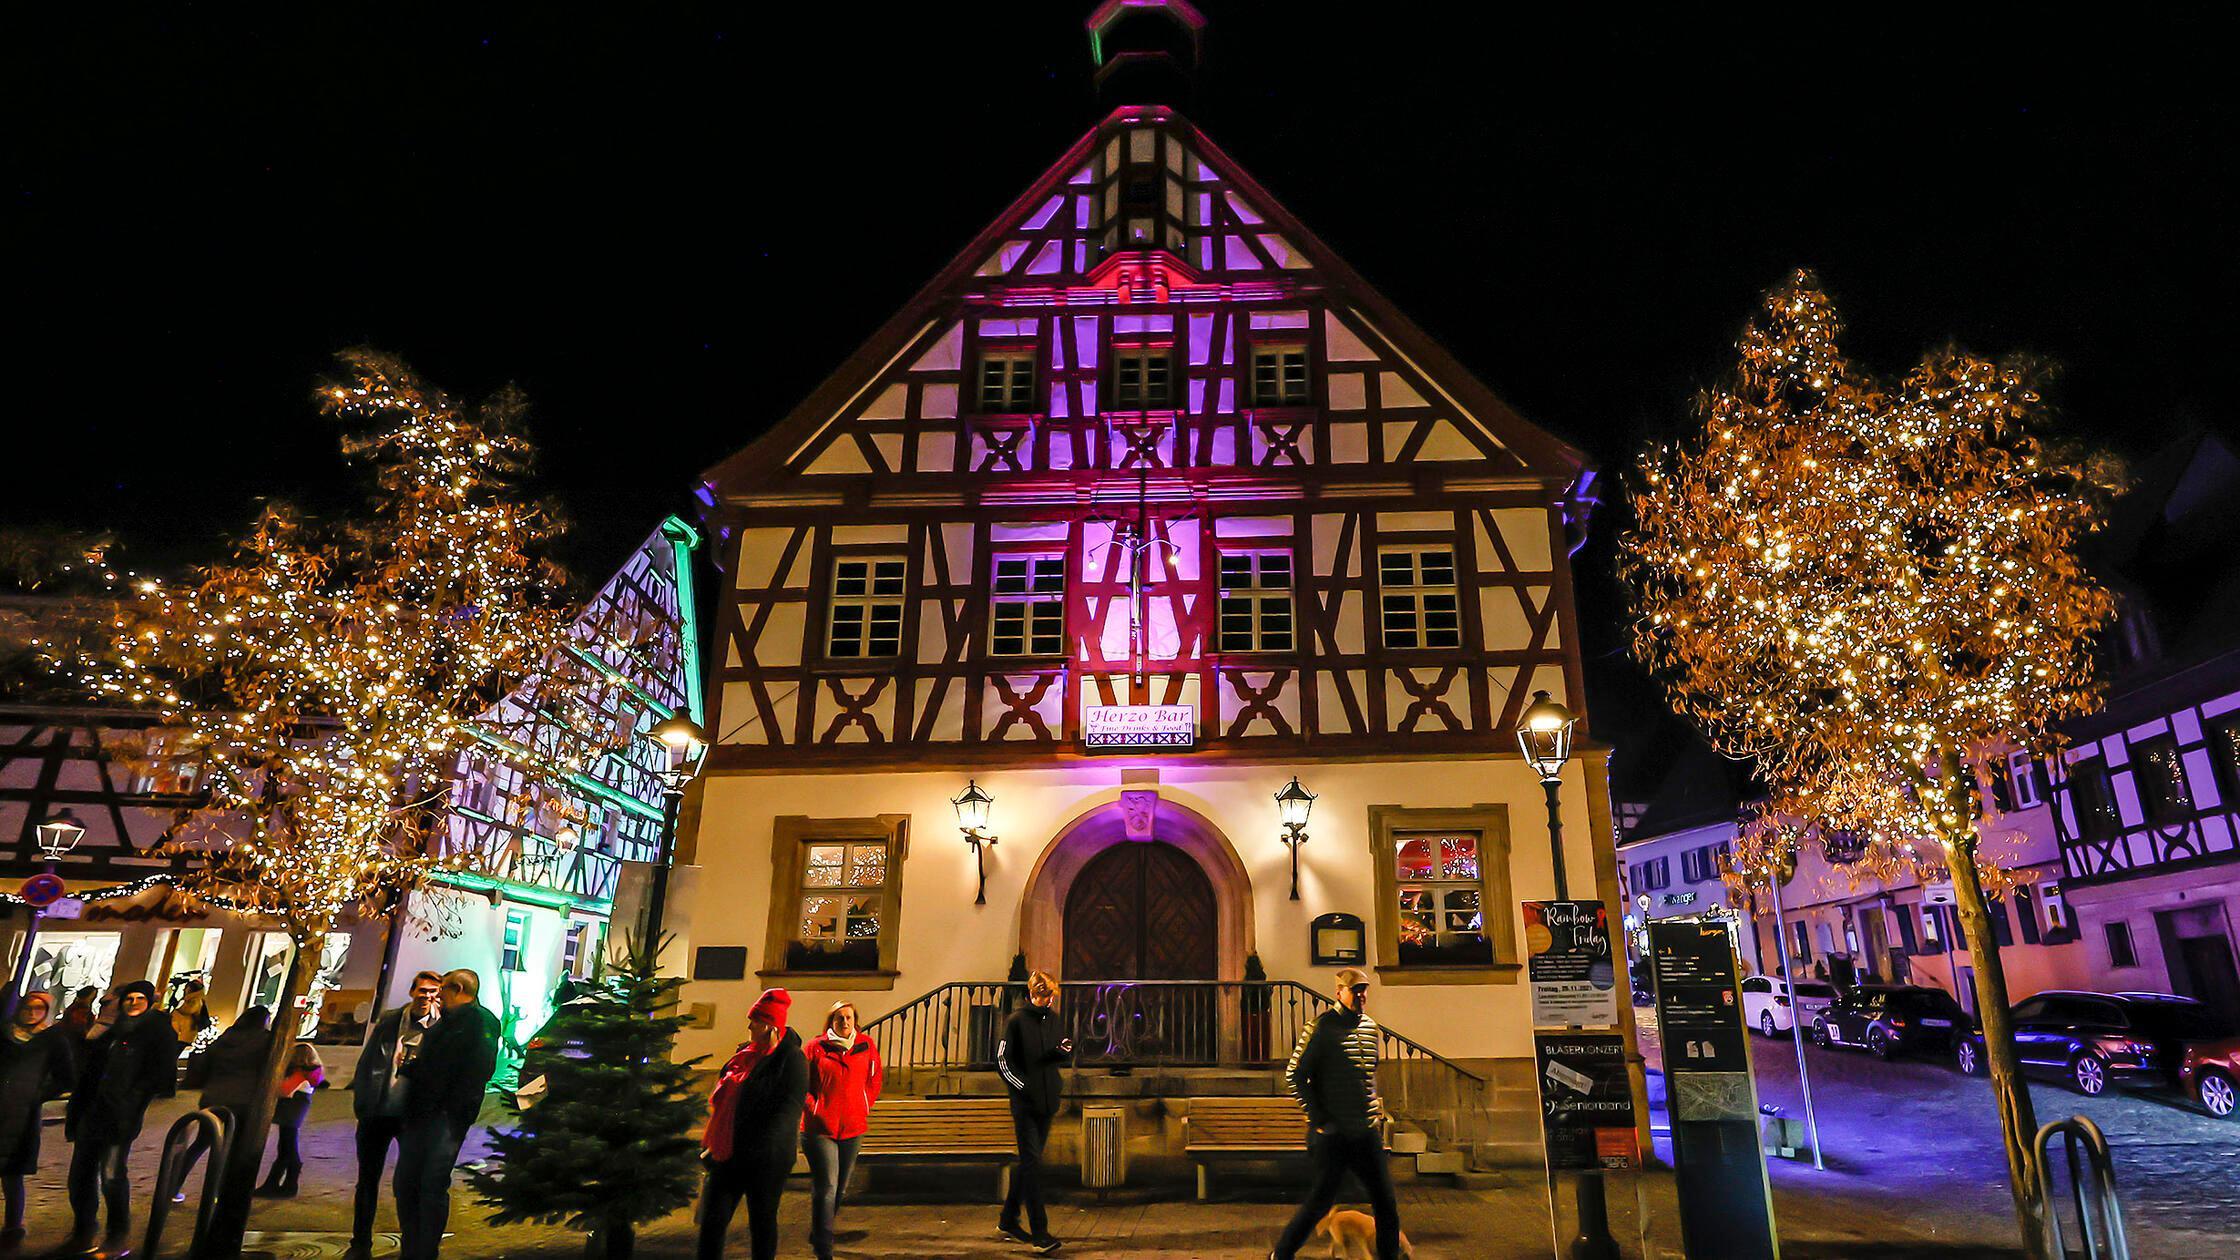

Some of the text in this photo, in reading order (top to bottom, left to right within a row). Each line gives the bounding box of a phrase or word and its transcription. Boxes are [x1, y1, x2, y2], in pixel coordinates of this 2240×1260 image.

[1091, 709, 1189, 722] Herzo Bar
[1152, 724, 1158, 732] &
[1544, 904, 1596, 927] Rainbow
[1573, 924, 1607, 956] Friday
